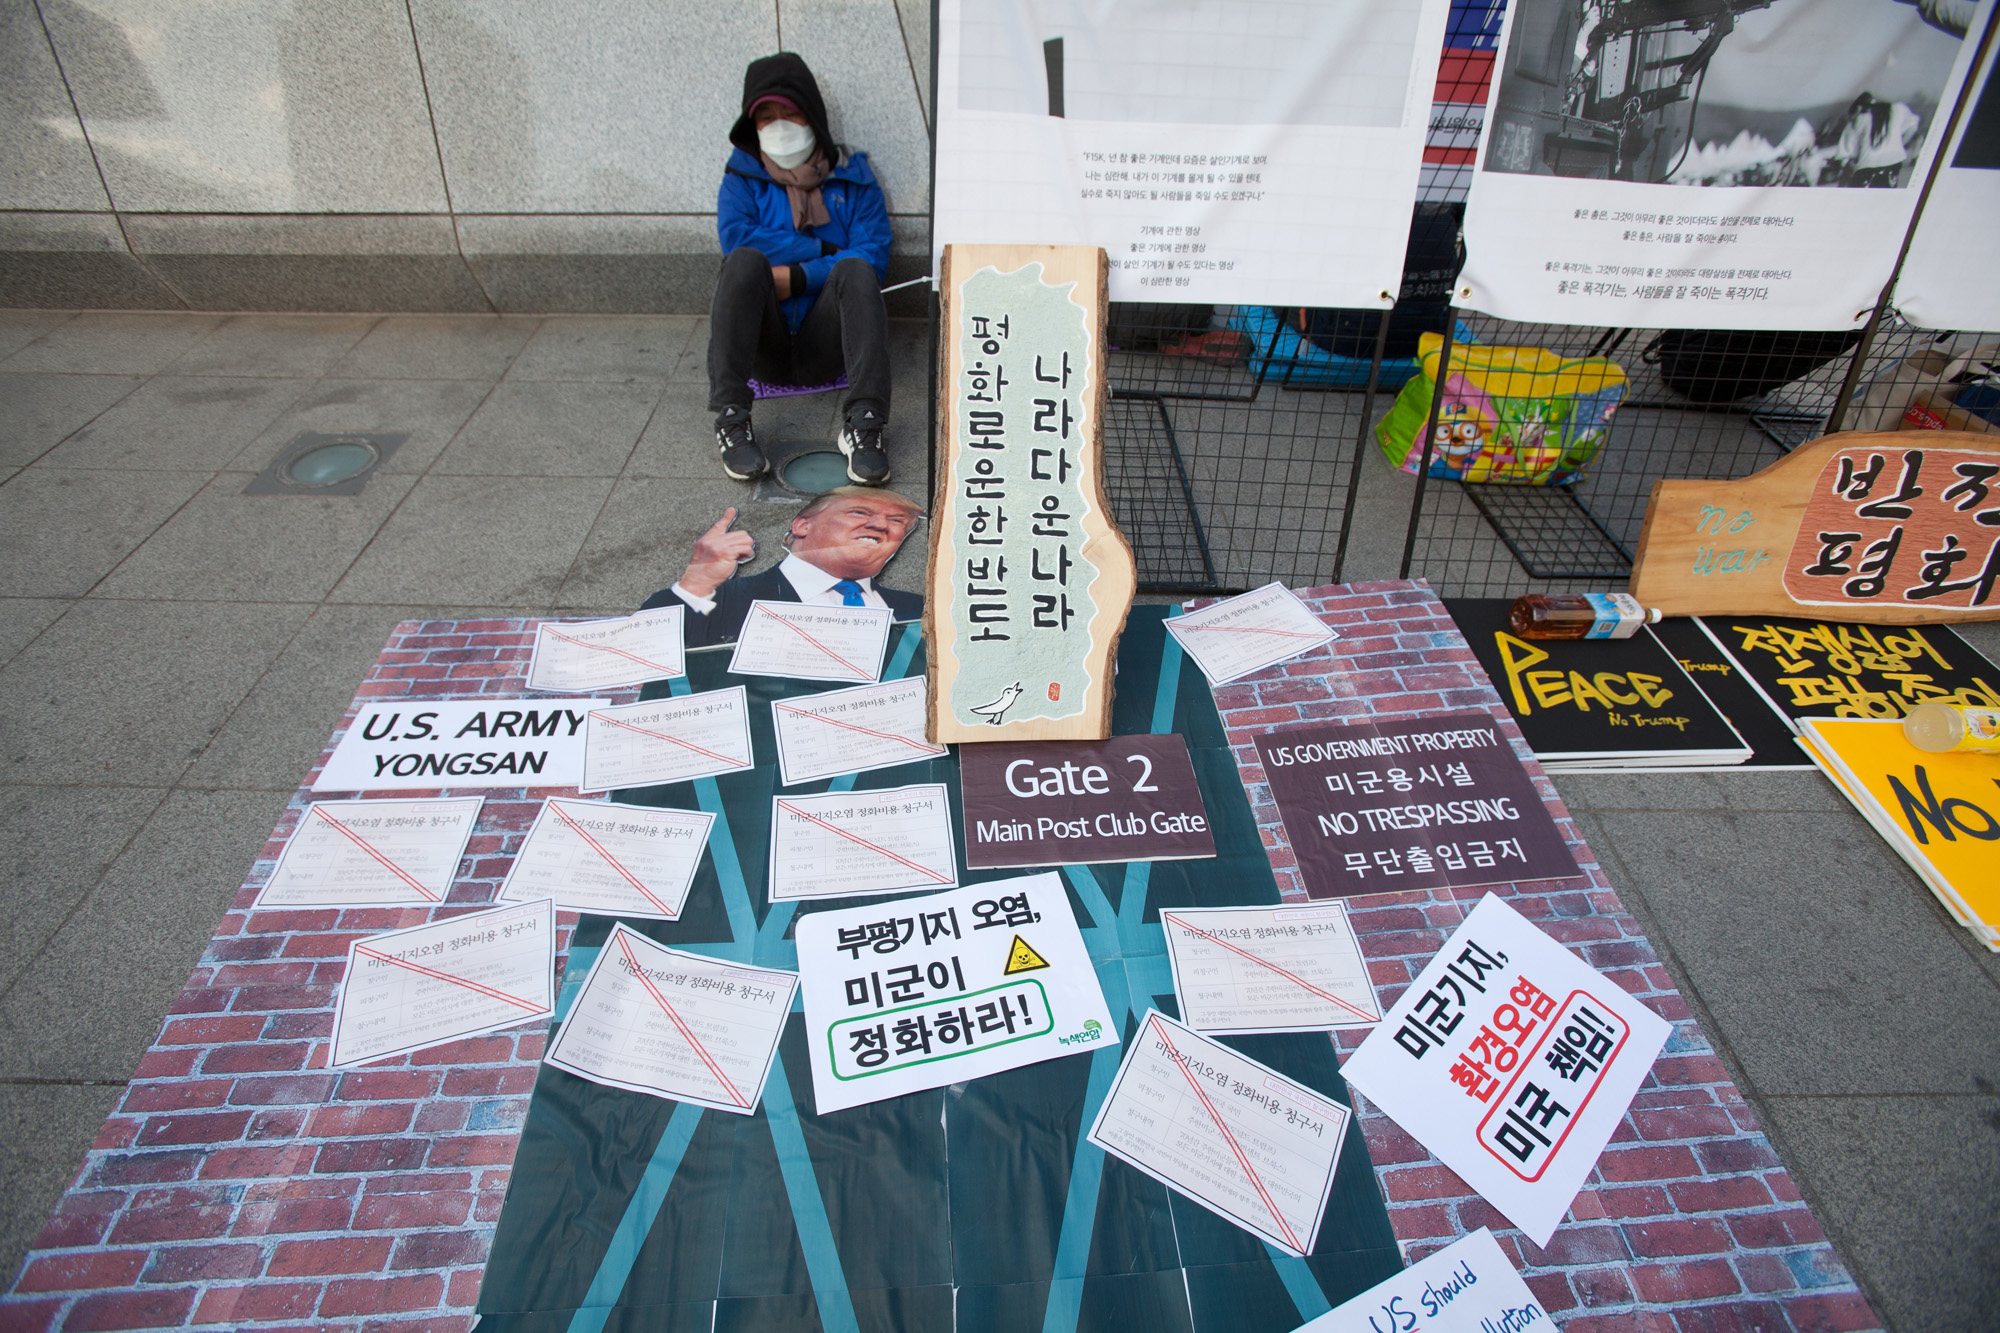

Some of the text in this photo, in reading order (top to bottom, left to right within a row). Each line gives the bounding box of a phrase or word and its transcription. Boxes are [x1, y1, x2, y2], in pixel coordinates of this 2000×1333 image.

[1109, 154, 1117, 163] 넌
[1120, 154, 1127, 163] 참
[1130, 154, 1146, 164] 좋은
[1149, 155, 1180, 164] 기계인데
[1184, 155, 1207, 165] 요즘은
[1210, 156, 1249, 165] 살인기계로
[1085, 171, 1101, 180] 나는
[1133, 172, 1148, 181] 내가
[1152, 173, 1159, 181] 이
[1162, 173, 1185, 182] 기계를
[1188, 174, 1204, 183] 몰게
[1207, 174, 1214, 183] 될
[1218, 174, 1225, 183] 수
[1228, 174, 1243, 183] 있을
[1081, 189, 1102, 199] 실수로
[1105, 189, 1121, 199] 죽지
[1124, 190, 1147, 200] 않아도
[1150, 190, 1157, 200] 될
[1160, 191, 1192, 201] 사람들을
[1195, 192, 1210, 200] 죽일
[1213, 192, 1228, 201] 수도
[1140, 226, 1200, 236] 기계에 관한 명상
[1574, 209, 1588, 219] 좋은
[1611, 212, 1633, 222] 그것이
[1635, 213, 1656, 223] 아무리
[1658, 214, 1673, 225] 좋은
[1676, 215, 1718, 226] 것이더라도
[1130, 243, 1206, 253] 좋은 기계에 관한 명상
[1623, 231, 1637, 241] 좋은
[1656, 233, 1681, 243] 사람을
[1684, 233, 1692, 243] 잘
[1696, 234, 1717, 244] 죽이는
[1124, 260, 1139, 269] 살인
[1142, 260, 1165, 269] 기계가
[1168, 261, 1175, 269] 될
[1177, 261, 1191, 270] 수도
[1194, 261, 1216, 270] 있다는
[1219, 261, 1234, 270] 명상
[1545, 262, 1560, 272] 좋은
[1595, 265, 1619, 275] 그것이
[1622, 266, 1644, 277] 아무리
[1646, 268, 1663, 278] 좋은
[1698, 269, 1735, 279] 대량살상을
[1737, 269, 1760, 279] 전제로
[1140, 277, 1189, 286] 이 심란한 명상
[1558, 281, 1769, 301] 좋은 폭격기는, 사람들을 잘 죽이는 폭격기다.
[1696, 505, 1757, 535] no
[1692, 546, 1770, 576] war
[1495, 630, 1674, 716] PEACE
[362, 710, 584, 742] U.S. ARMY
[1629, 712, 1690, 731] Trump
[1268, 728, 1499, 767] US GOVERNMENT PROPERTY
[374, 751, 548, 778] YONGSAN
[1005, 754, 1159, 798] Gate 2
[856, 803, 900, 817] 정화비용
[902, 800, 933, 813] 청구서
[1317, 797, 1521, 837] NO TRESPASSING
[976, 811, 1207, 843] Main Post Club Gate
[1344, 836, 1528, 879] 무단출입금지
[501, 919, 537, 939] 청구서
[837, 892, 1042, 960] 부평기지 오염,
[1183, 923, 1336, 940] 미군기지오염 정화비용 청구서
[618, 957, 687, 986] 미군기지오염
[688, 974, 736, 996] 정화비용
[739, 985, 775, 1005] 청구서
[845, 956, 967, 1009] 미군이
[1393, 939, 1510, 1060] 미군기지,
[849, 994, 1033, 1068] 정화하라!
[1059, 1029, 1100, 1045] 녹색연합
[1448, 975, 1558, 1104] 환경오염
[1155, 1040, 1324, 1138] 미군기지오염 정화비용 청구서
[1494, 1006, 1616, 1163] 미국 책임!
[1369, 1260, 1478, 1333] US should
